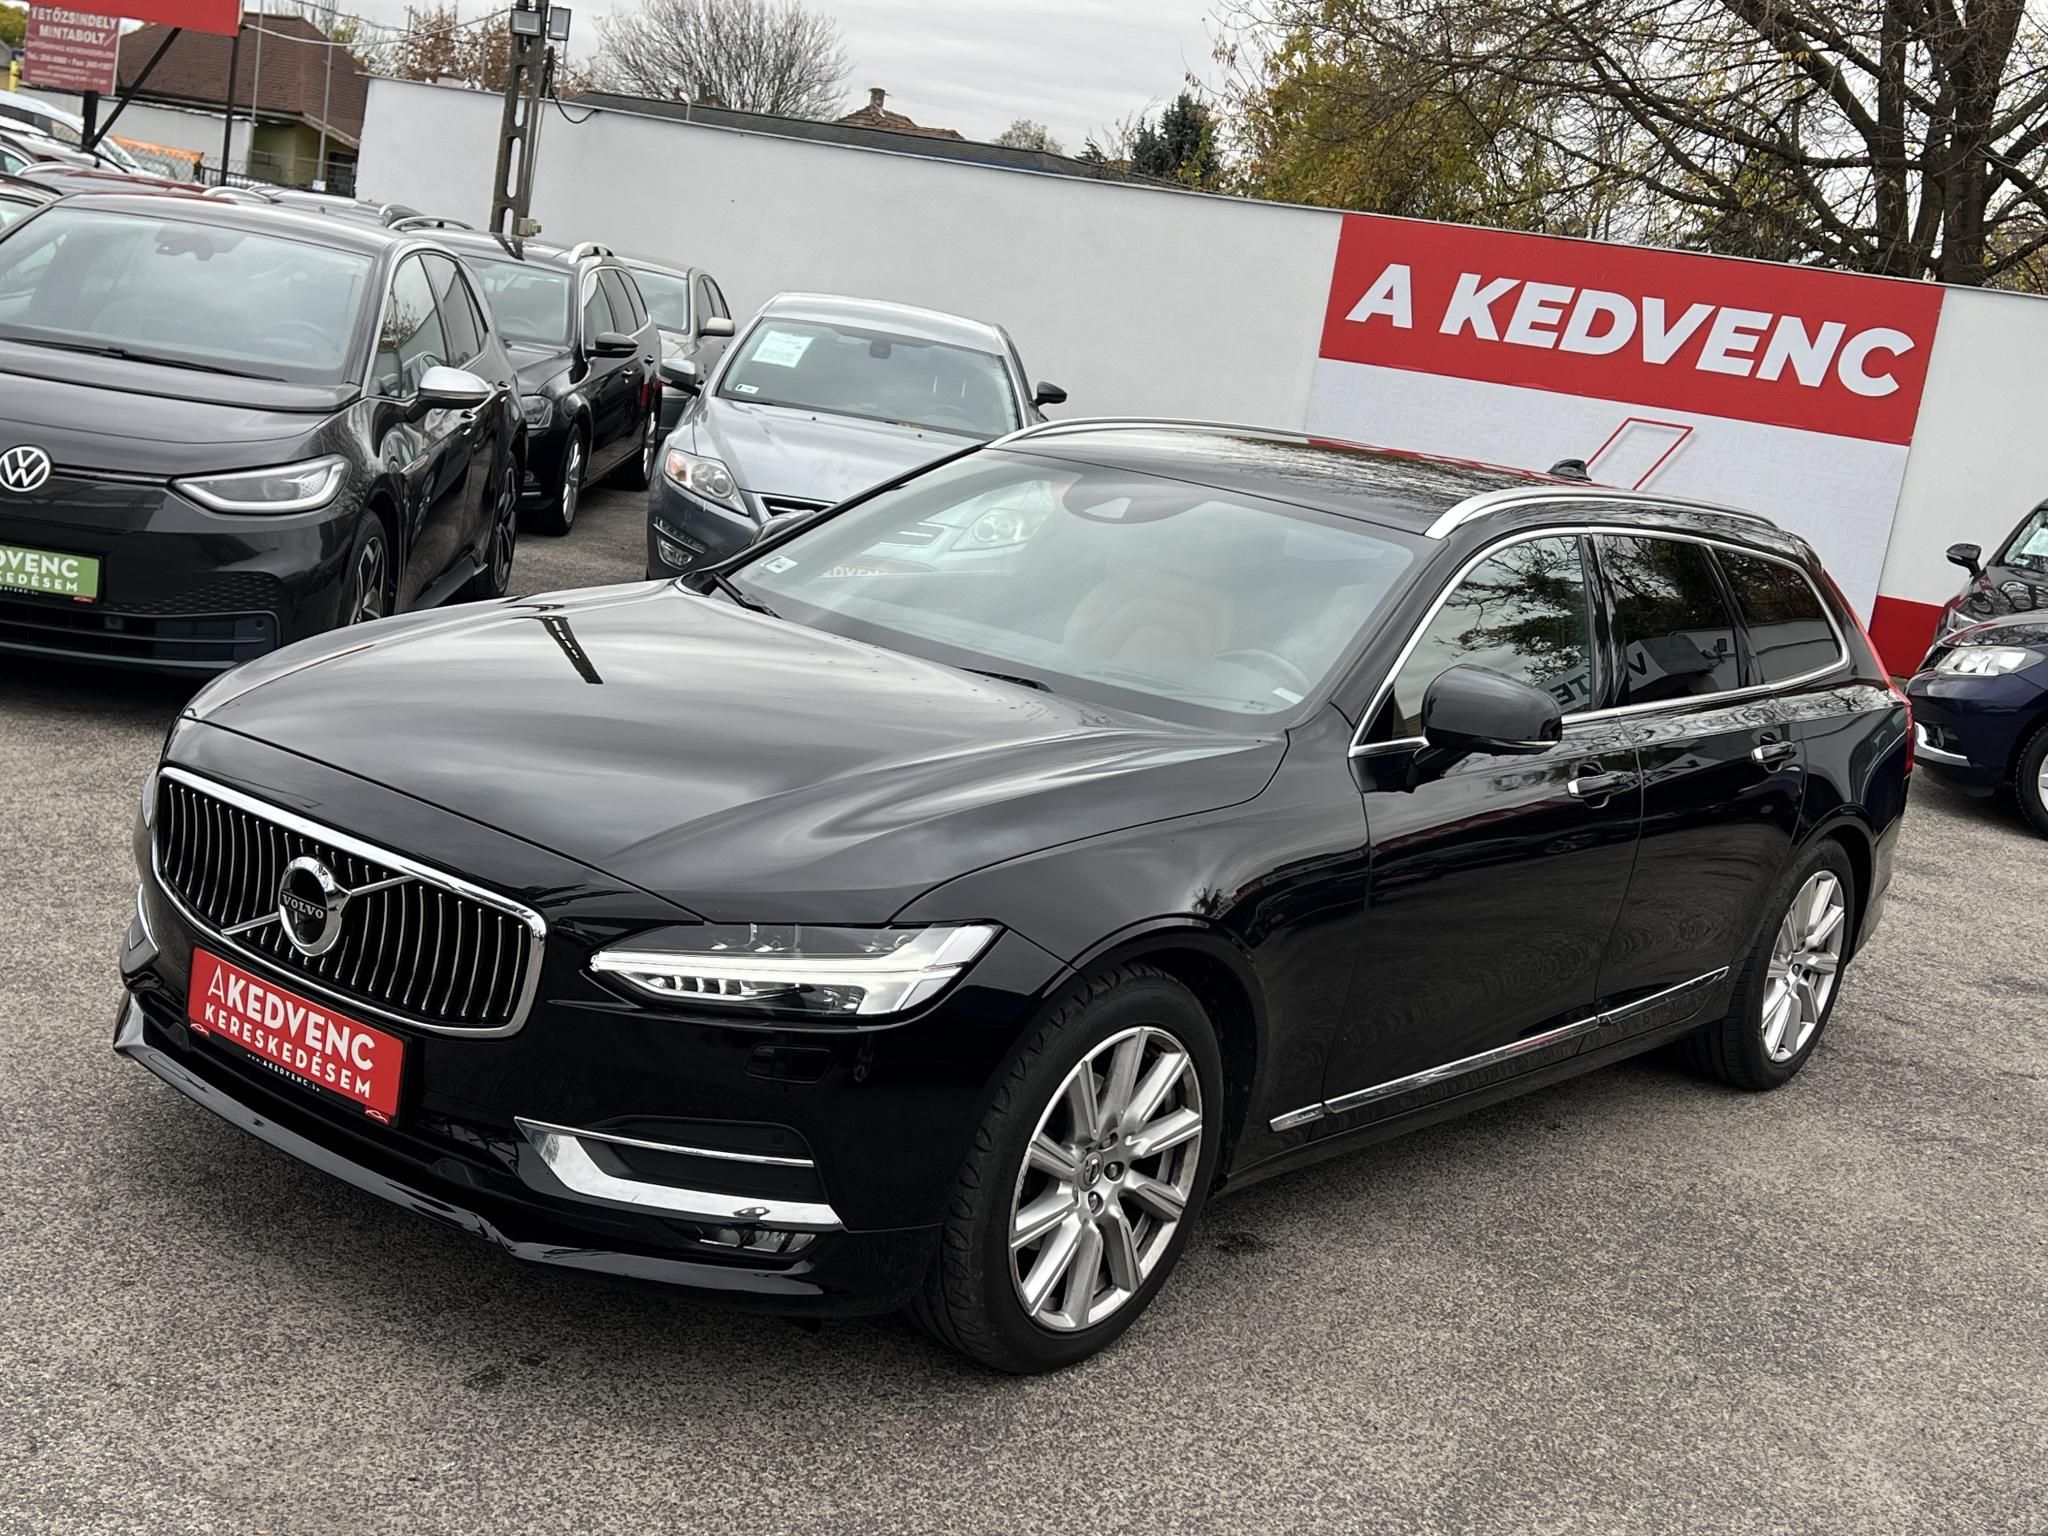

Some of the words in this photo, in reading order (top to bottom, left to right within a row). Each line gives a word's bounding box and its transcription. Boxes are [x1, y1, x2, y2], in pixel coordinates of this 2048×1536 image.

[1345, 264, 1412, 329] A
[1439, 273, 1915, 396] KEDVENC
[0, 572, 78, 592] EDÉSEM
[282, 894, 324, 919] VOLVO
[204, 1002, 371, 1098] KERESKEDÉSEM
[207, 964, 375, 1071] AKEDVENC
